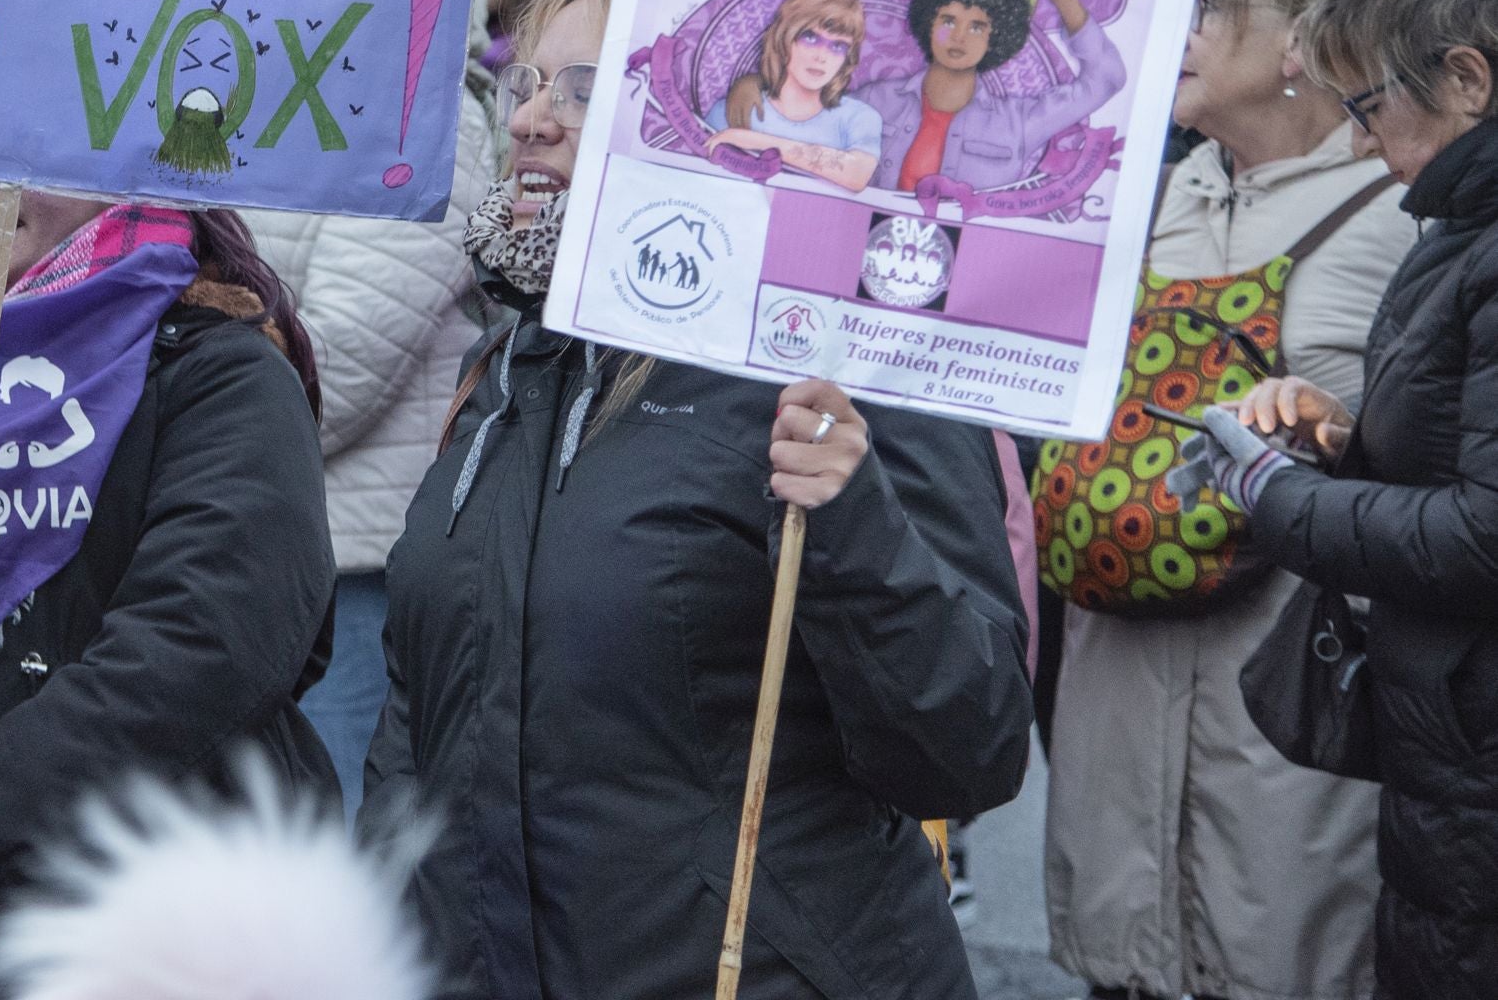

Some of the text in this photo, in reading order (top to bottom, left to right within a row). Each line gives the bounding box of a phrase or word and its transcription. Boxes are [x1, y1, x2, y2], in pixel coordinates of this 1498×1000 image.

[667, 198, 699, 211] Estatal
[697, 206, 712, 219] por
[891, 215, 937, 250] 8M
[676, 315, 688, 324] de
[837, 312, 926, 345] Mujeres
[928, 332, 1080, 375] pensionistas
[845, 341, 1065, 398] También feministas
[923, 381, 995, 405] 8 Marzo
